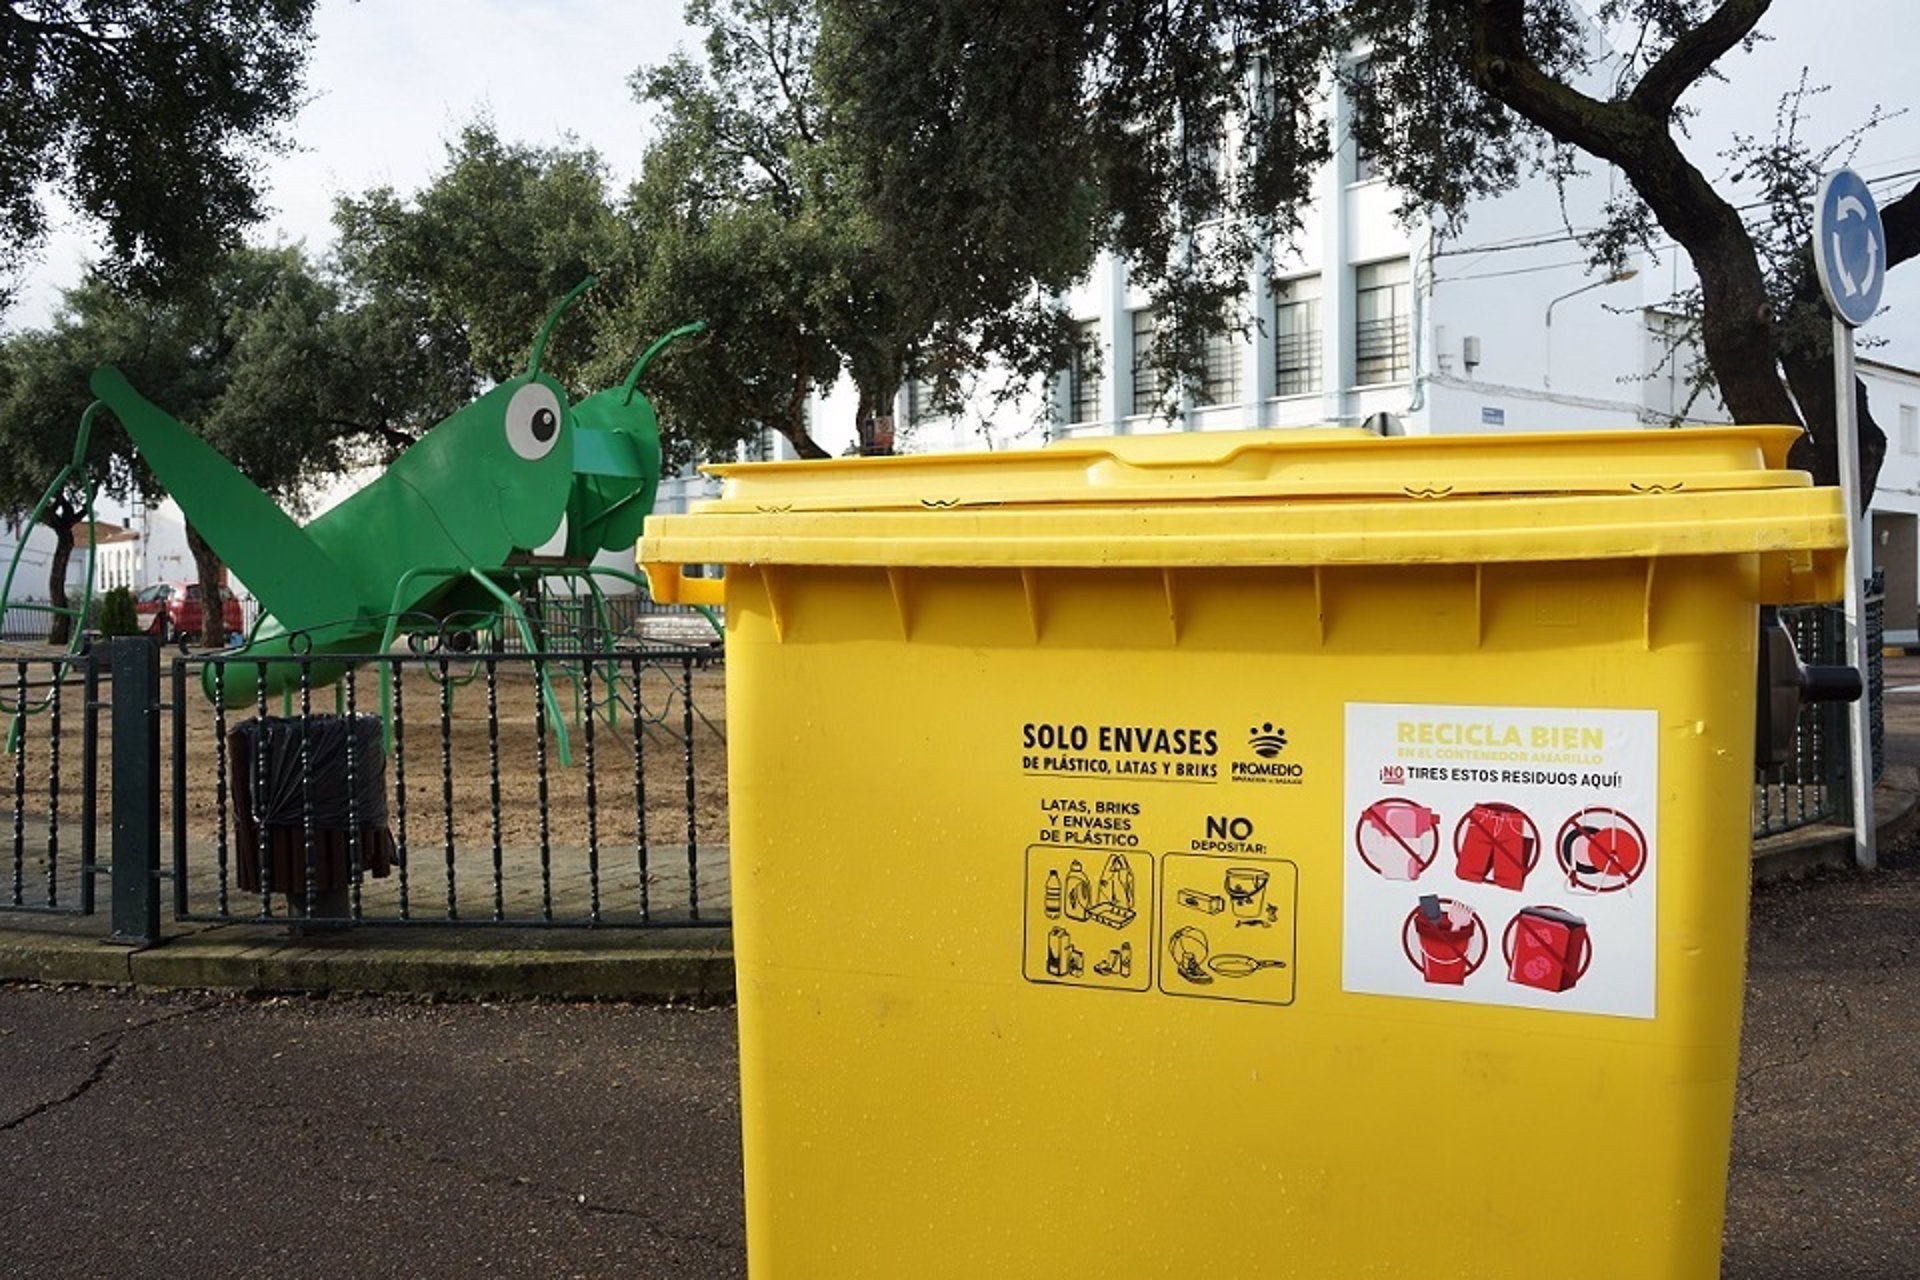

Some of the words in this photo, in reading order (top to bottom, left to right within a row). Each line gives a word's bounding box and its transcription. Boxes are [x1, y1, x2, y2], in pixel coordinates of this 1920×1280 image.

[1022, 723, 1088, 751] SOLO
[1099, 726, 1218, 757] ENVASES
[1397, 721, 1522, 747] RECICLA
[1531, 726, 1603, 749] BIEN
[1398, 748, 1414, 758] EN
[1418, 748, 1431, 758] EL
[1435, 750, 1527, 762] CONTENEDOR
[1532, 753, 1603, 765] AMARILLO
[1023, 756, 1040, 769] DE
[1043, 754, 1111, 774] PLÁSTICO,
[1116, 760, 1157, 775] LATAS
[1162, 762, 1172, 776] Y
[1176, 762, 1217, 778] BRIKS
[1231, 762, 1303, 777] PROMEDIO
[1379, 766, 1404, 782] ¡NO
[1408, 766, 1447, 780] TIRES
[1451, 768, 1498, 782] ESTOS
[1502, 770, 1577, 786] RESIDUOS
[1581, 770, 1622, 789] AQUÍ!
[1041, 798, 1091, 814] LATAS,
[1096, 801, 1140, 815] BRIKS
[1048, 815, 1058, 826] Y
[1063, 817, 1131, 830] ENVASES
[1206, 815, 1253, 841] NO
[1040, 830, 1060, 842] DE
[1065, 829, 1139, 847] PLÁSTICO
[1191, 839, 1267, 854] DEPOSITAR:
